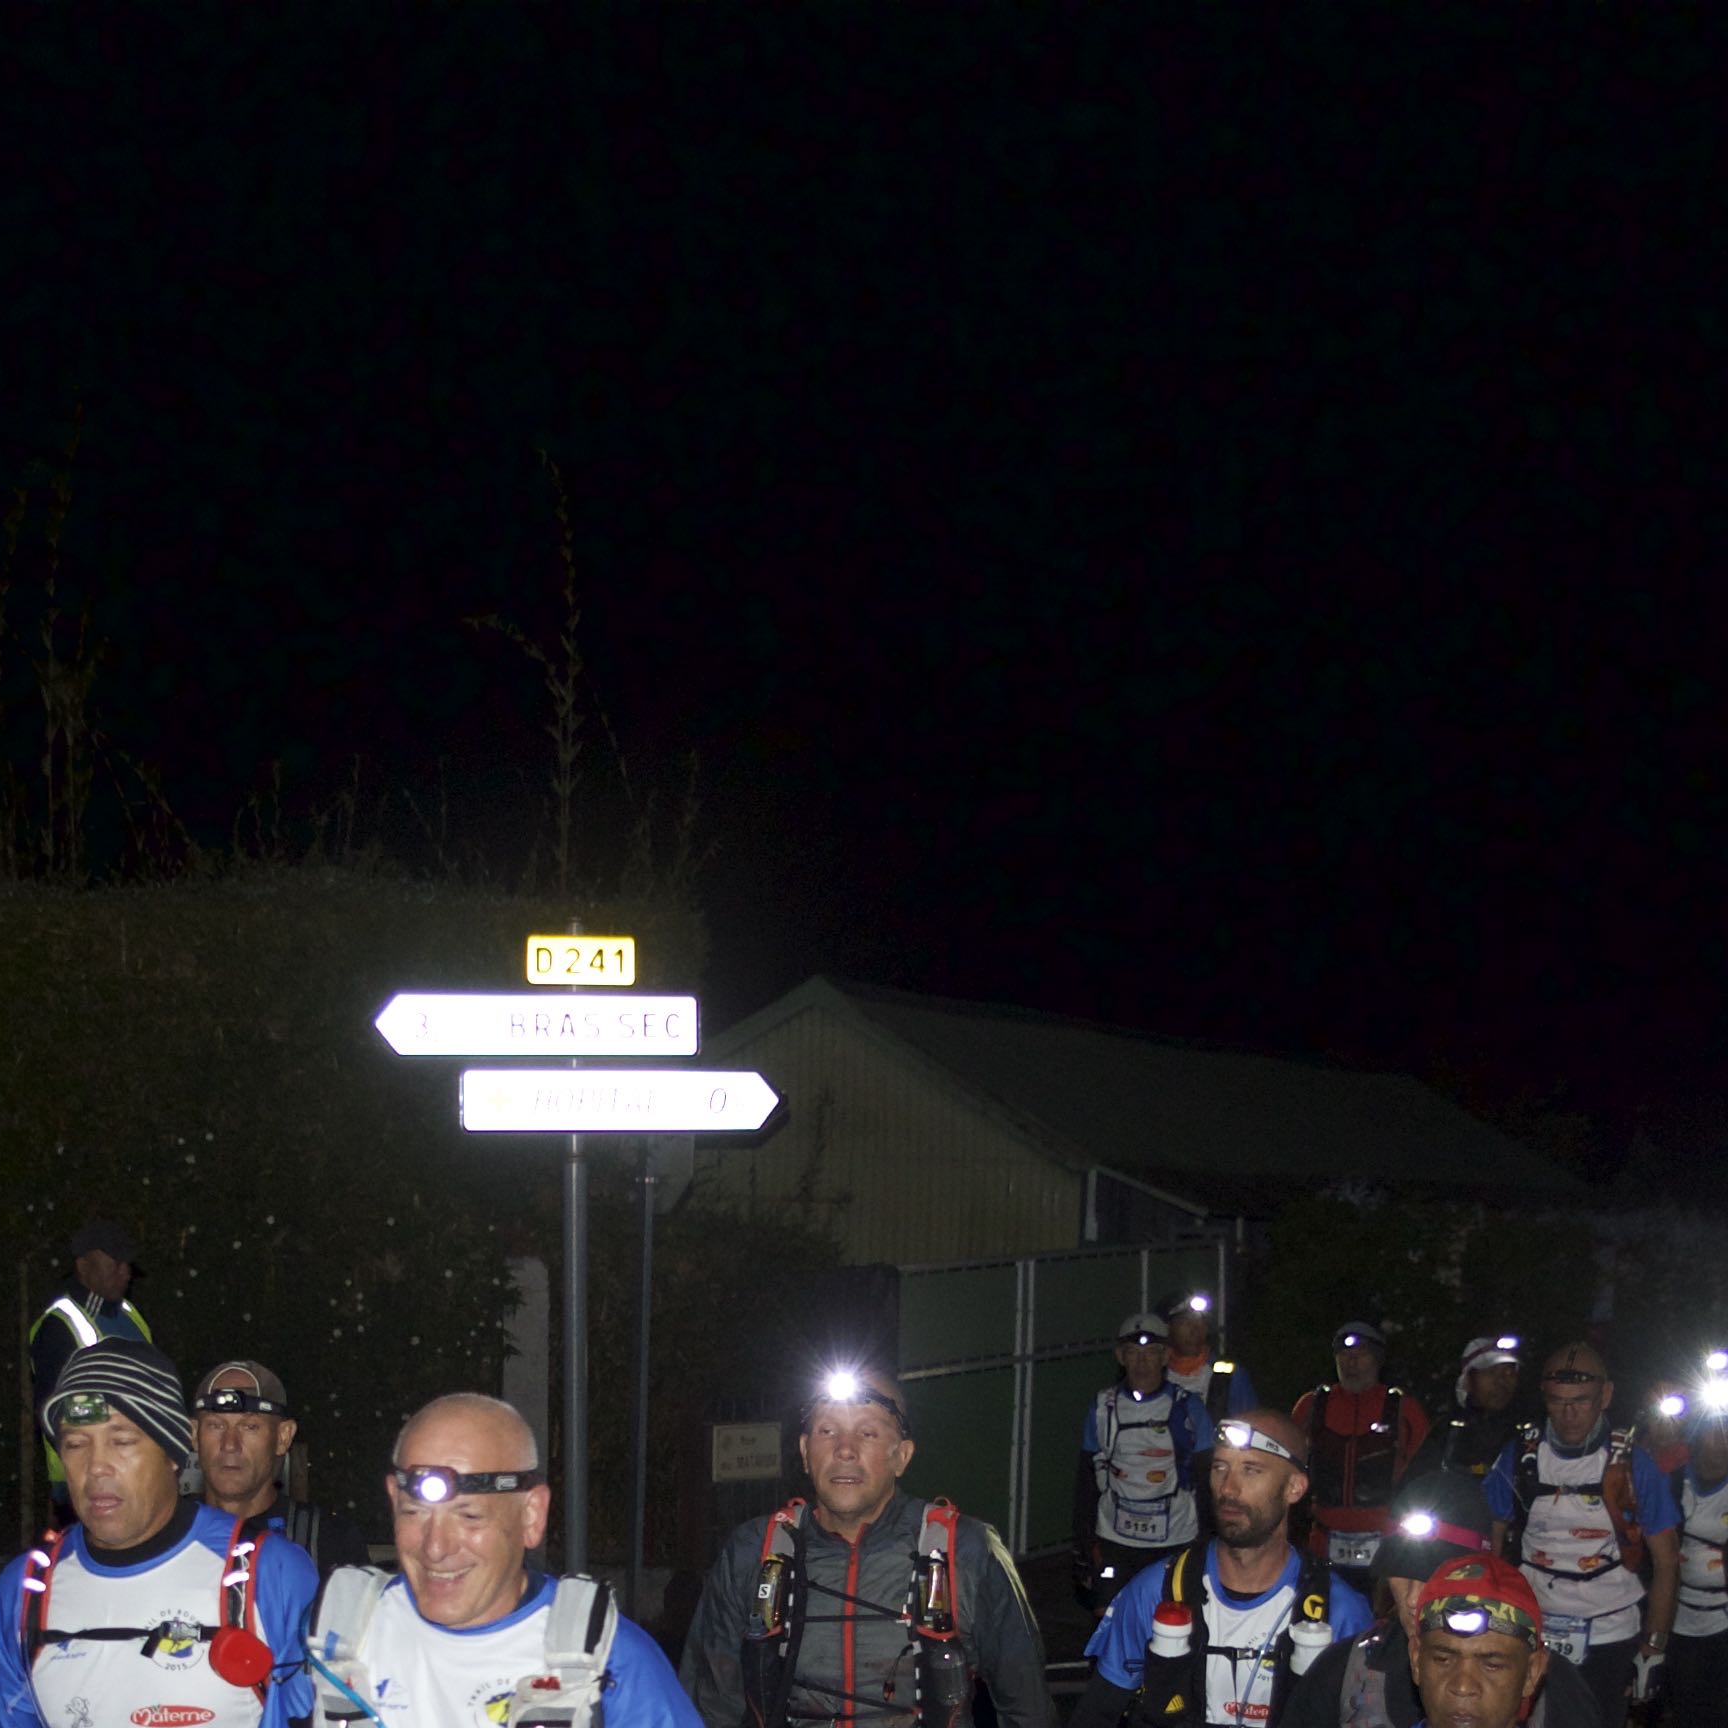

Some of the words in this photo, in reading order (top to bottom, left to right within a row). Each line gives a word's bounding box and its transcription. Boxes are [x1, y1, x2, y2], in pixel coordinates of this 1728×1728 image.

[536, 947, 553, 973] D
[566, 947, 625, 974] 241
[510, 1012, 601, 1039] BRAS
[618, 1012, 681, 1039] SEC
